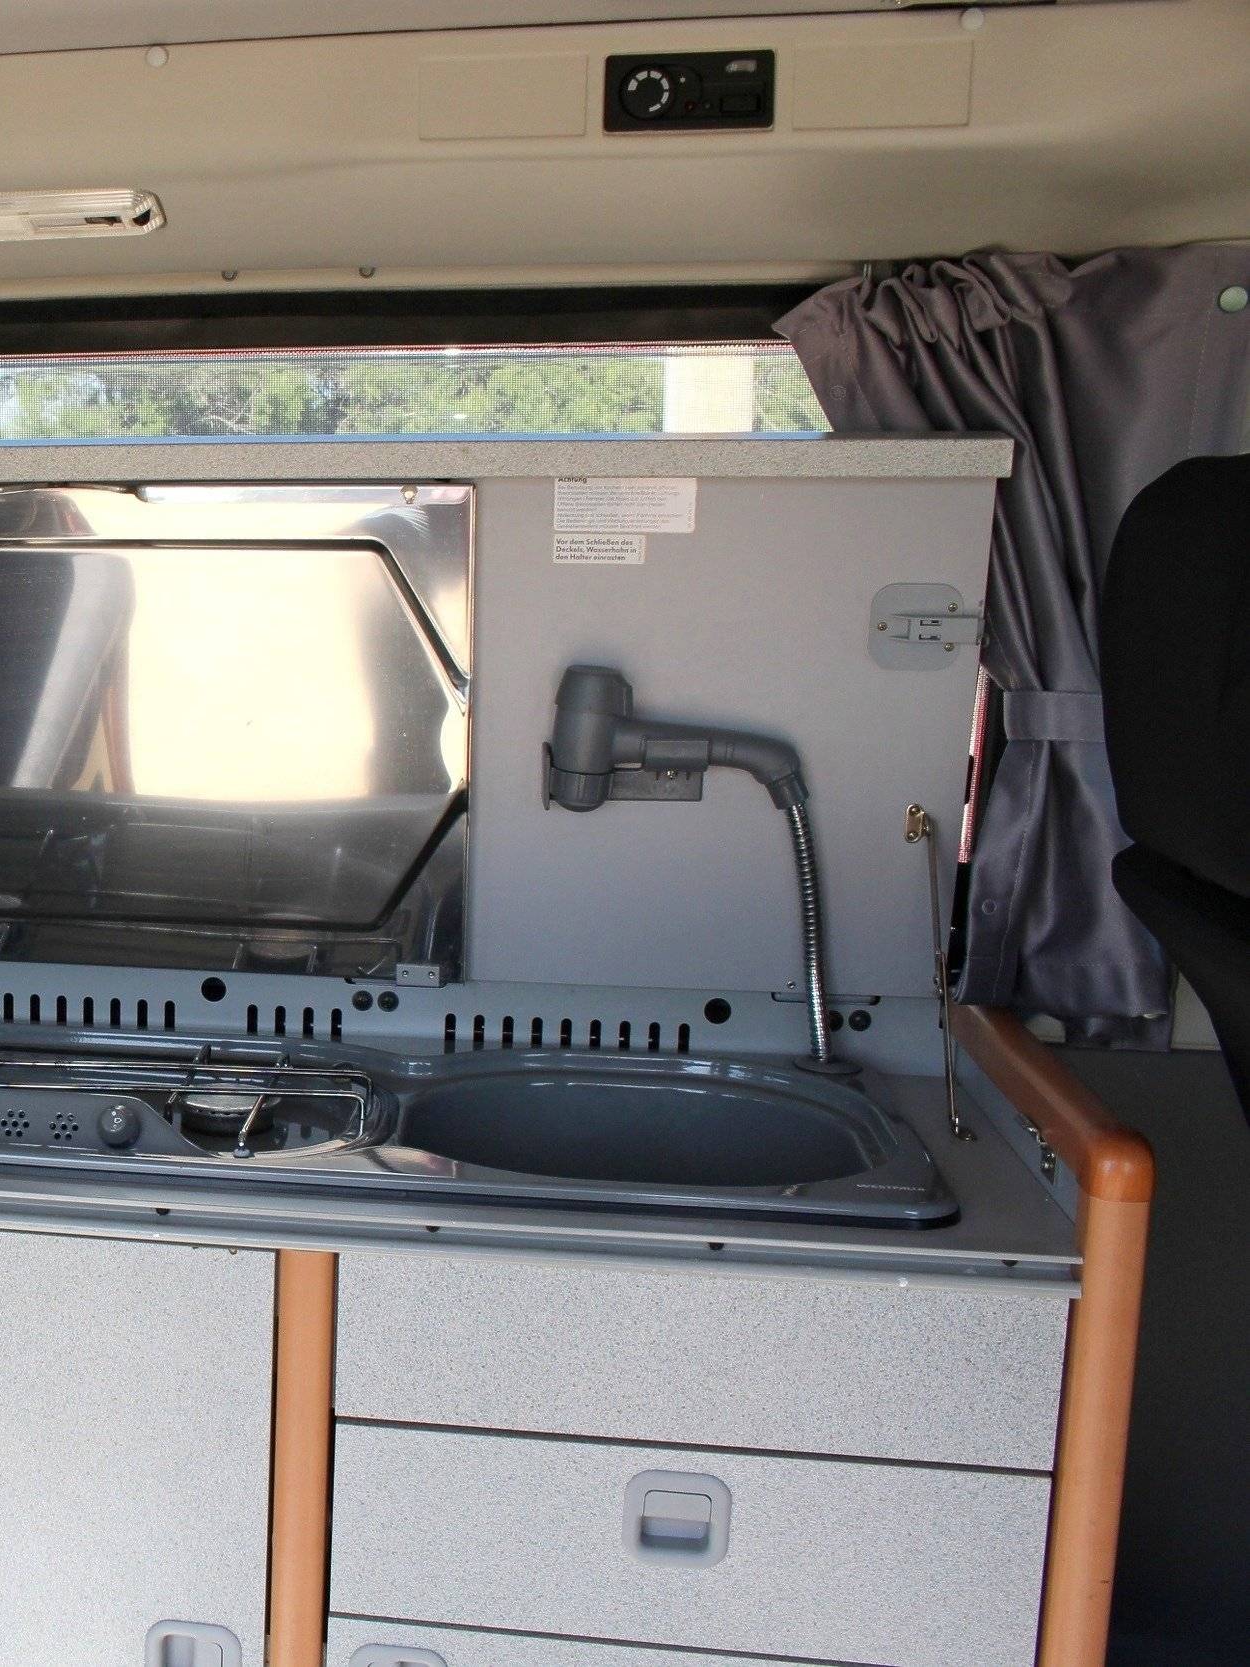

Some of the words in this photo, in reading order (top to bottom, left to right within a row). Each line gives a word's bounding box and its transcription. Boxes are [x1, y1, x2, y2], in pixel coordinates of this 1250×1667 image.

[569, 538, 584, 546] dem
[586, 538, 619, 546] Schließen
[586, 546, 629, 554] Wasserhahn
